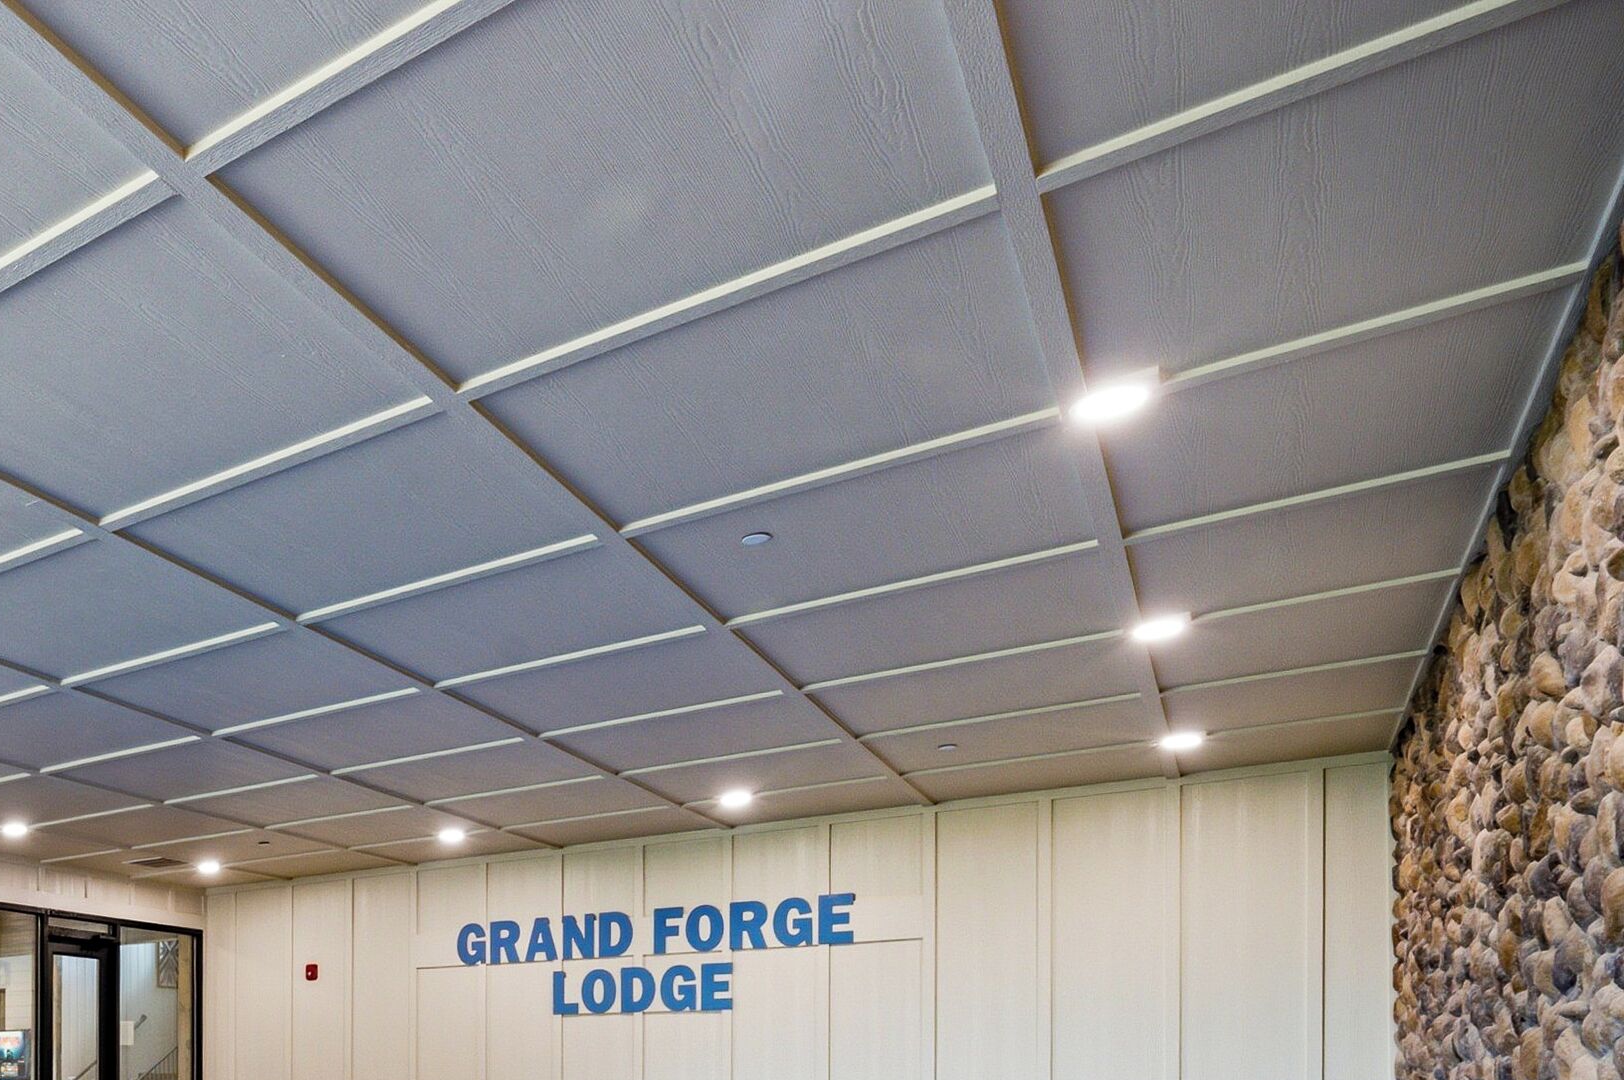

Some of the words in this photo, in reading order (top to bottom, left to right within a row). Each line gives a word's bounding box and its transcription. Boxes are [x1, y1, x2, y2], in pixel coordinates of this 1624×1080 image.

[457, 912, 634, 966] GRAND
[653, 893, 856, 953] FORGE
[552, 962, 733, 1015] LODGE
